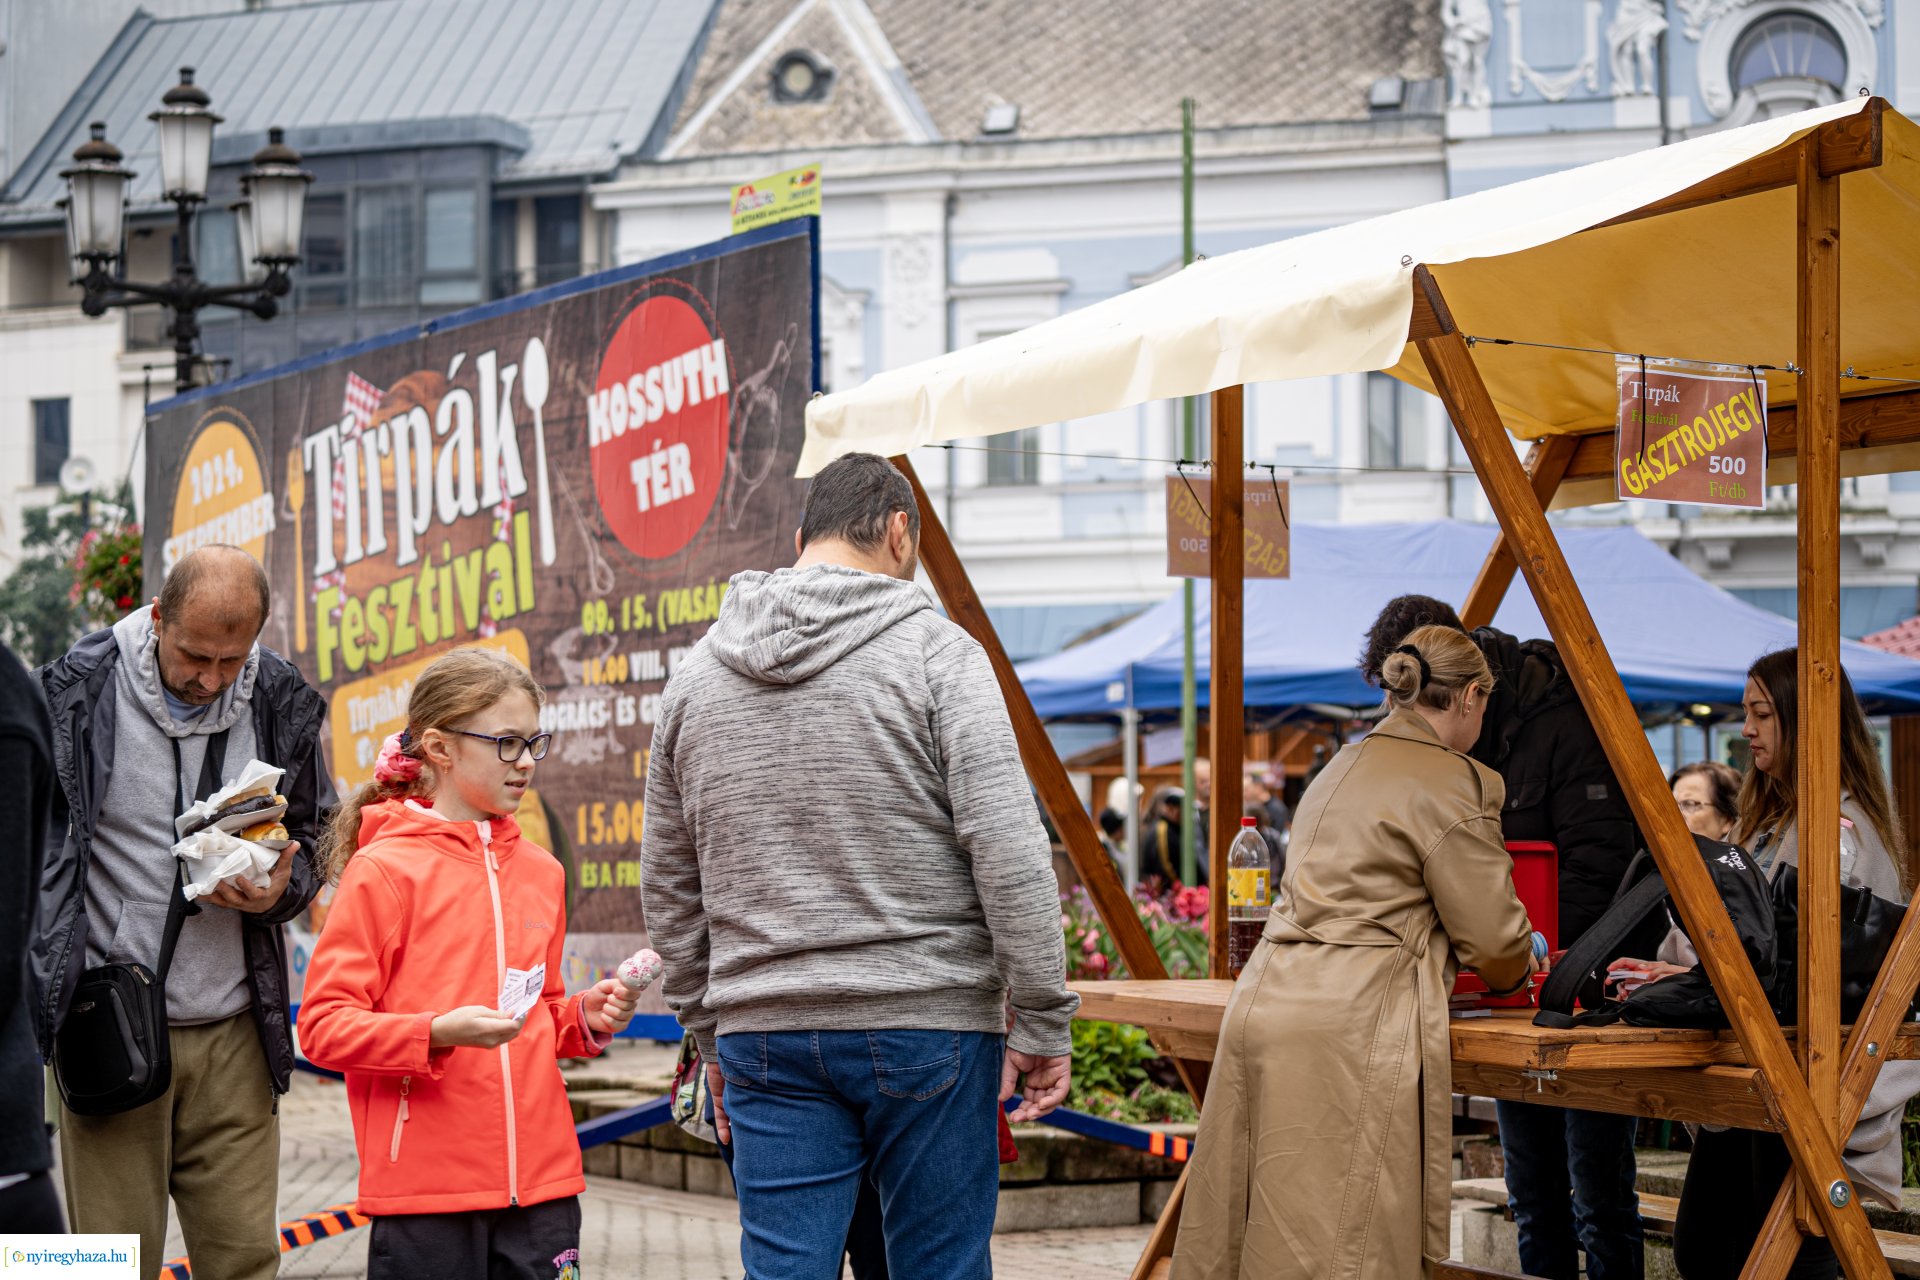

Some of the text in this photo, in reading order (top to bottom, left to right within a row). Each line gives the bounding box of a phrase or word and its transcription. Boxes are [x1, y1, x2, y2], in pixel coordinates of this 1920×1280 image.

[588, 338, 730, 448] KOSSUTH
[1629, 381, 1681, 407] Tirpák
[1631, 409, 1680, 427] Fesztivál
[1621, 387, 1762, 495] GASZTROJEGY
[190, 447, 244, 506] 2024.
[304, 350, 528, 577] Tirpák
[630, 439, 695, 513] TÉR
[1709, 455, 1746, 475] 500
[1709, 480, 1747, 499] Ft/db
[315, 510, 536, 683] Fesztivál
[581, 599, 615, 636] 09.
[621, 594, 653, 632] 15.
[582, 653, 629, 687] 10.00
[616, 691, 637, 727] ÉS
[576, 800, 646, 846] 15.00
[601, 862, 613, 888] A
